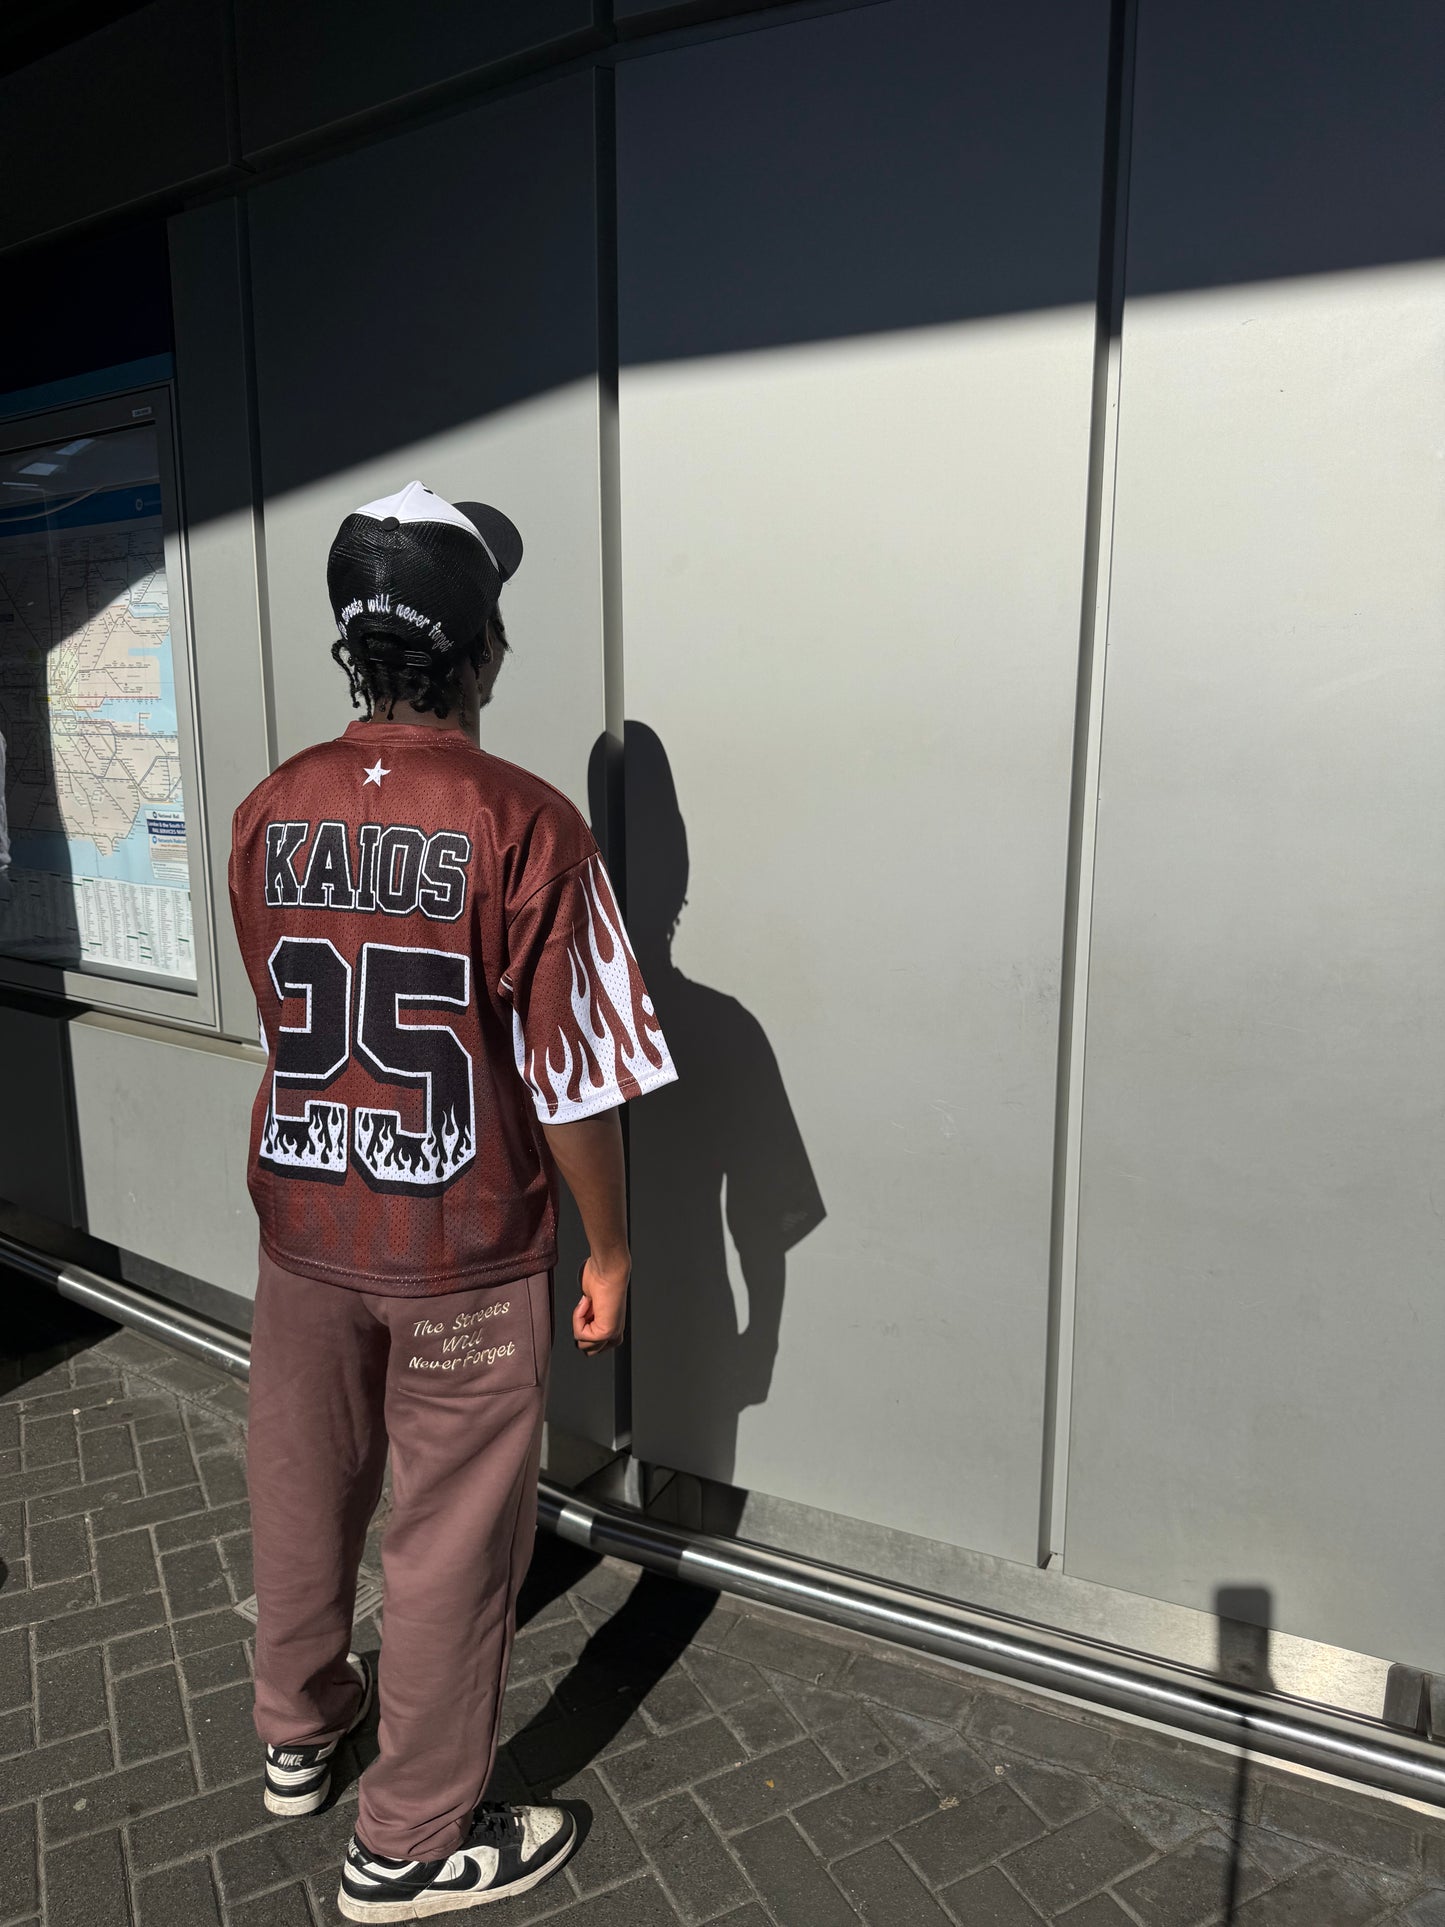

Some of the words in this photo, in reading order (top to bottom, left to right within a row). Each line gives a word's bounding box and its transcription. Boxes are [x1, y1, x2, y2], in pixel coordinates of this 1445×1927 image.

[367, 593, 391, 614] will
[395, 603, 431, 629] never
[428, 621, 455, 653] forget
[264, 821, 471, 923] KAIOS
[259, 935, 477, 1196] 25
[413, 1319, 445, 1337] The
[452, 1301, 511, 1330] Streets
[408, 1356, 462, 1371] Never
[462, 1341, 516, 1368] Forget
[442, 1328, 483, 1353] Will
[277, 1752, 304, 1766] NIKE
